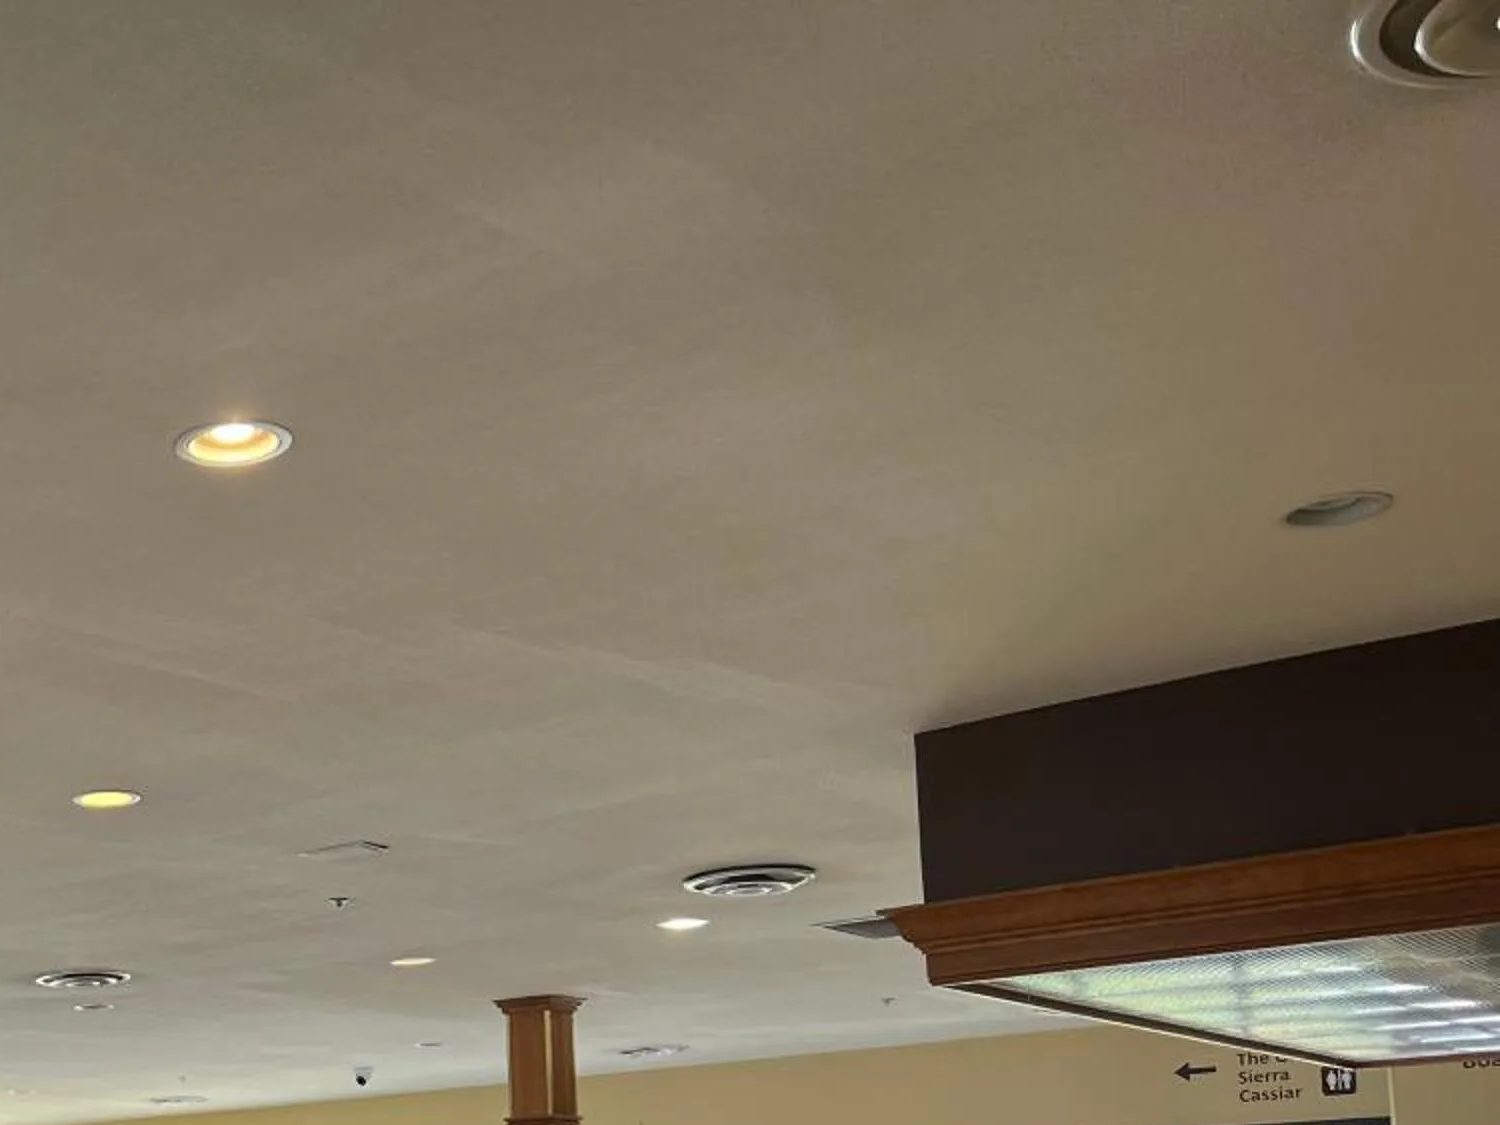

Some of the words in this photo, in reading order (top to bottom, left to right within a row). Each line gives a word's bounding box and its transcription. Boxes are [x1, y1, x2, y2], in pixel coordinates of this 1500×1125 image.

[1237, 1052, 1268, 1066] The
[1238, 1070, 1290, 1085] Sierra
[1240, 1087, 1303, 1102] Cassiar
